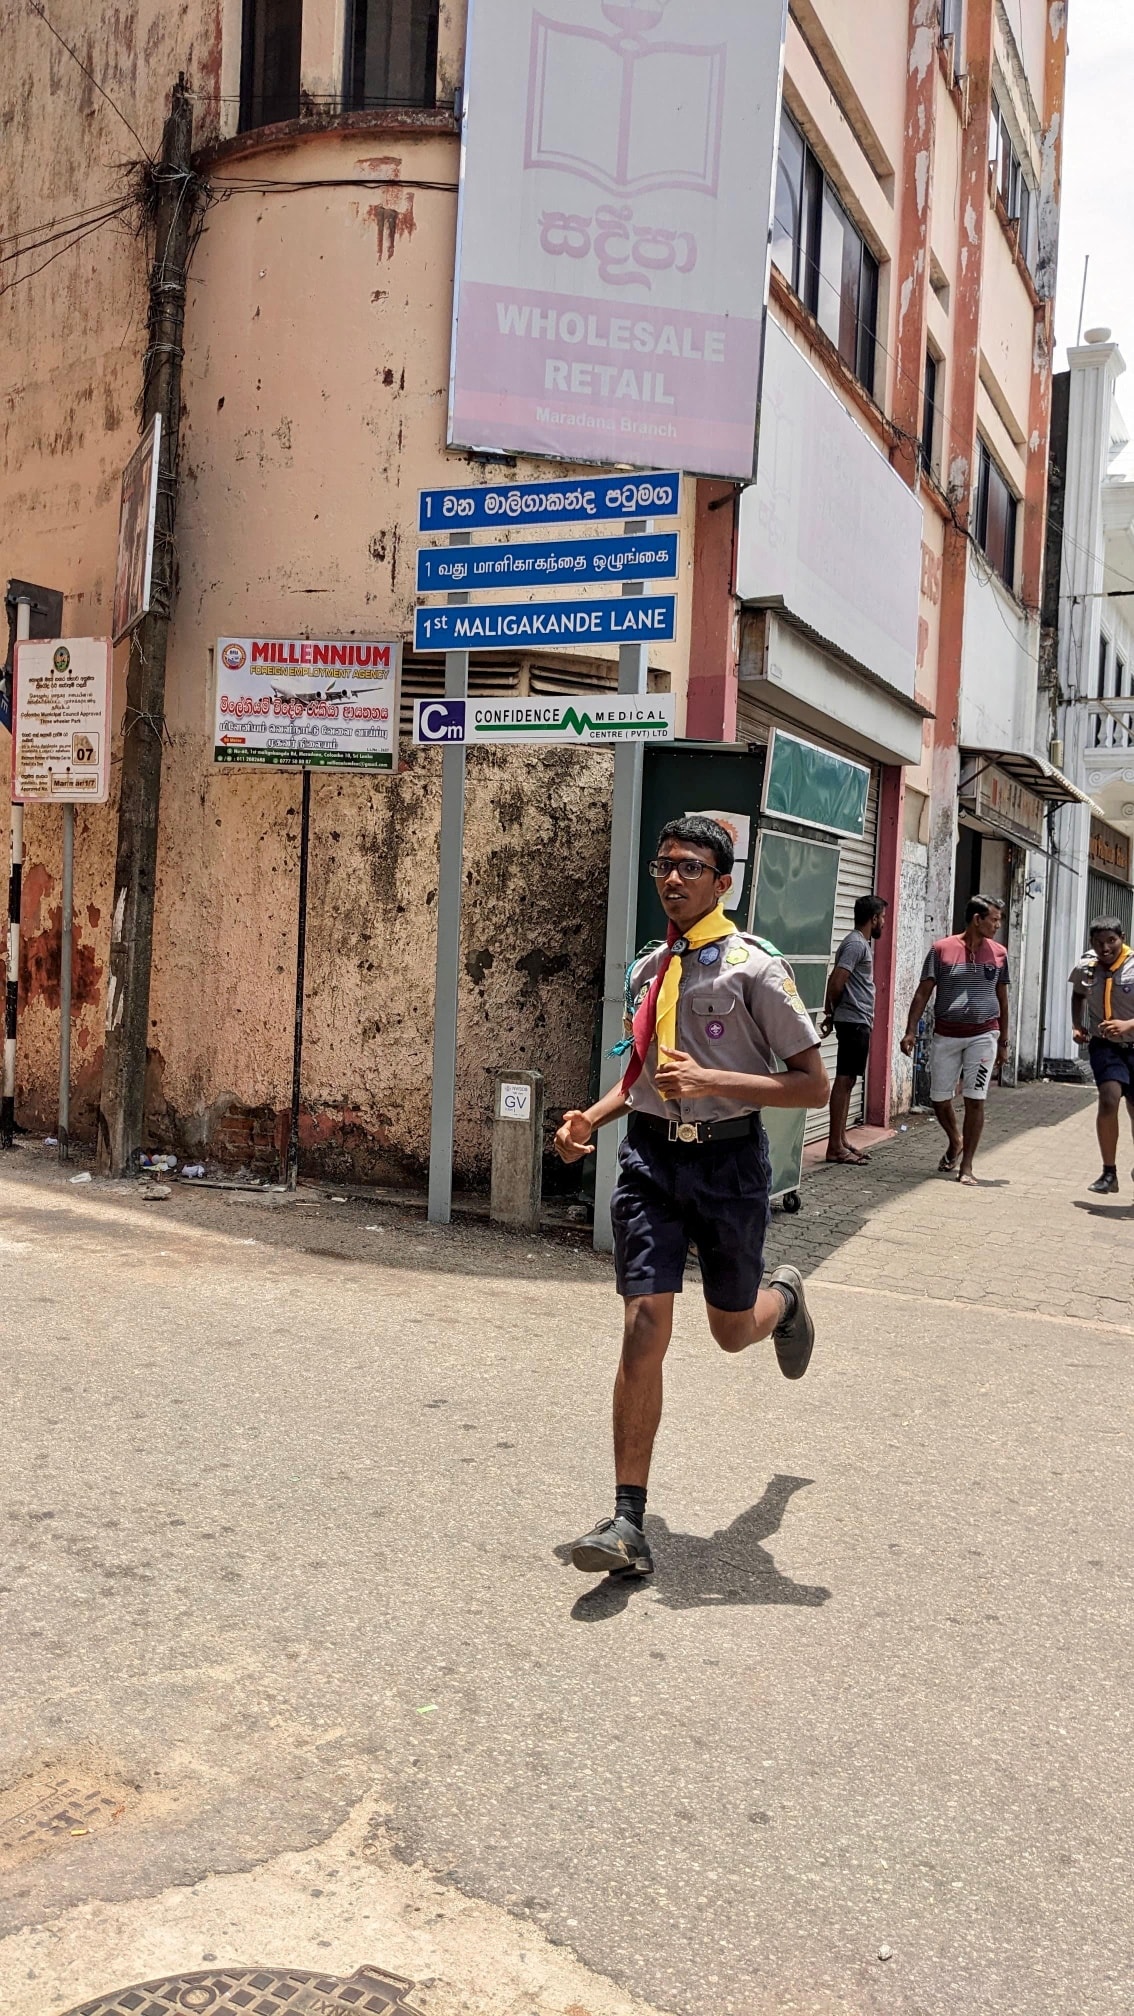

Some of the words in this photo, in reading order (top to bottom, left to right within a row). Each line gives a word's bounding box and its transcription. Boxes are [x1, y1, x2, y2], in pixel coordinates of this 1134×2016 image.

[496, 303, 725, 362] WHOLESALE
[544, 359, 675, 405] RETAIL
[535, 406, 615, 432] Maradana
[619, 415, 677, 438] Branch
[425, 496, 432, 518] 1
[443, 496, 475, 517] වන
[485, 488, 597, 517] මාලිගාකන්ද
[606, 483, 672, 512] පටුමග
[426, 562, 431, 577] 1
[438, 562, 468, 580] வது
[474, 553, 587, 574] மாளிகாகந்தை
[593, 547, 669, 572] ஒழுங்கை
[454, 612, 602, 637] MALIGAKANDE
[610, 609, 666, 631] LANE
[251, 642, 390, 666] MILLENNIUM
[250, 666, 289, 675] FOREIGN
[289, 667, 350, 679] EMPLOYMENT
[352, 669, 389, 680] AGENCY
[475, 709, 560, 723] CONFIDENCE
[595, 711, 666, 721] MEDICAL
[590, 730, 622, 738] CENTRE
[652, 730, 668, 738] LTD
[77, 749, 93, 761] 07
[505, 1095, 527, 1109] GV
[37, 1787, 81, 1812] WATER
